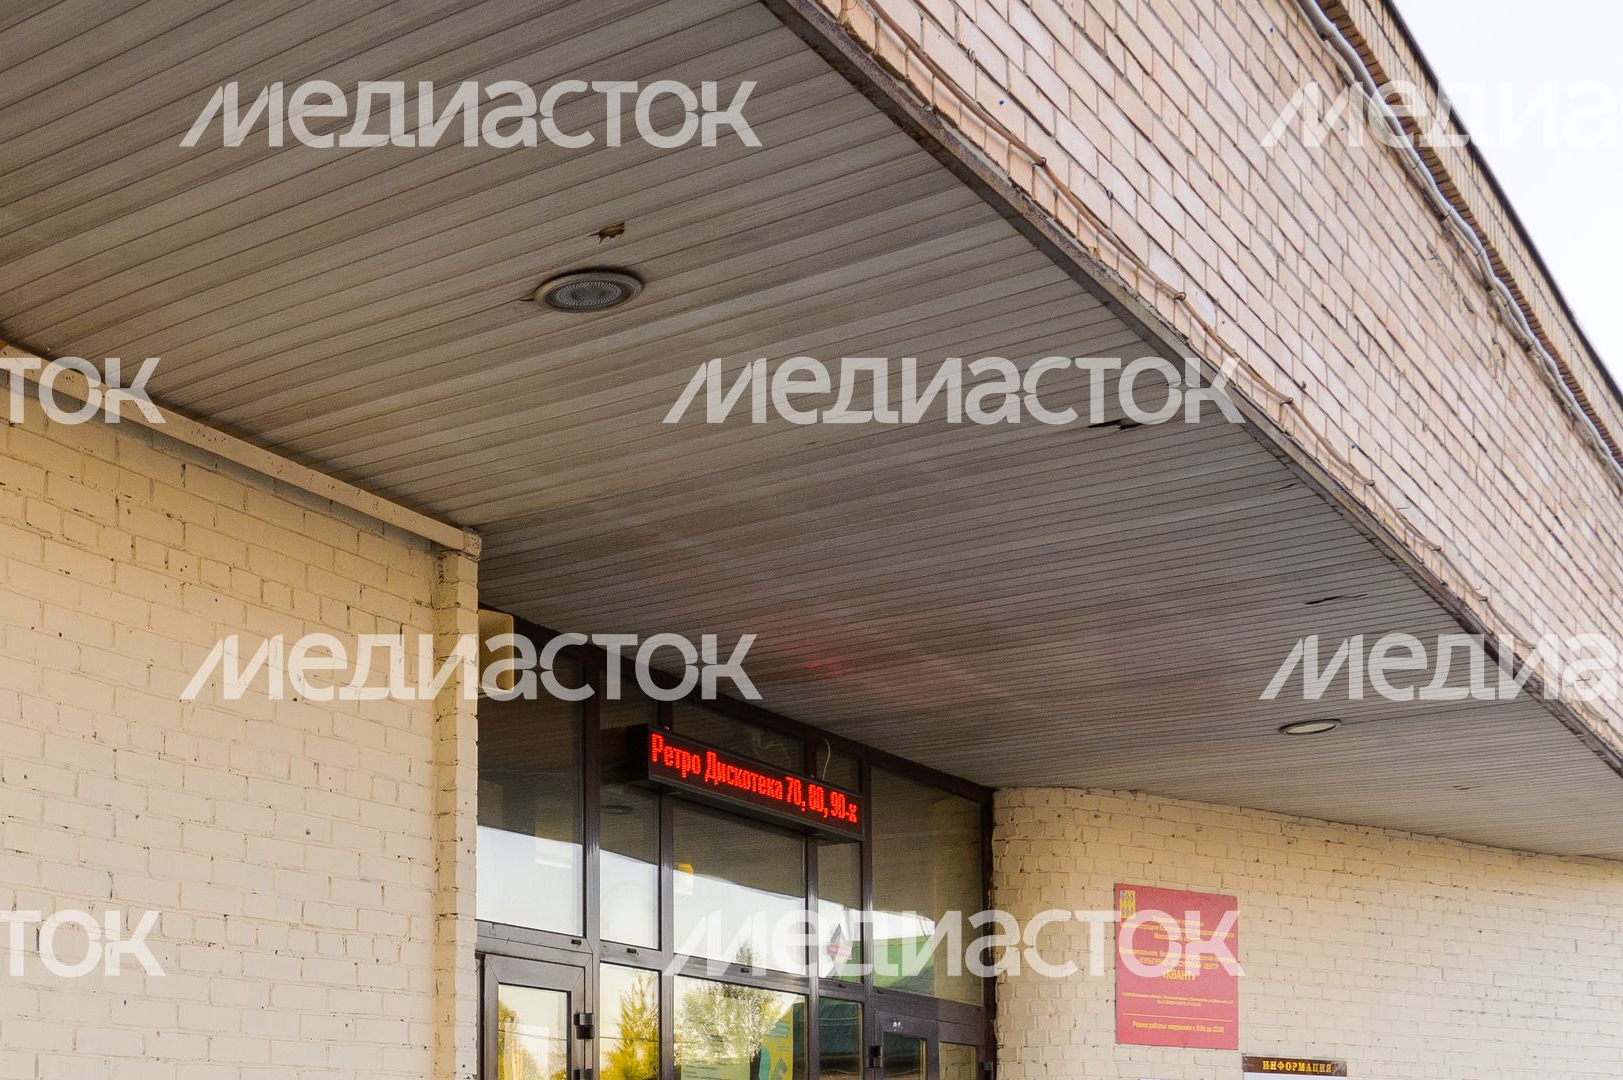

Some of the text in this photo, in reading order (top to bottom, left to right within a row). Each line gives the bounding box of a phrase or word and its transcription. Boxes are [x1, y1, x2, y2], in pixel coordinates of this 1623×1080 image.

[651, 732, 701, 778] Ретро
[704, 750, 783, 800] Дискотека
[807, 784, 829, 818] 80,
[1262, 1060, 1332, 1073] ИНФОРМАЦИЯ
